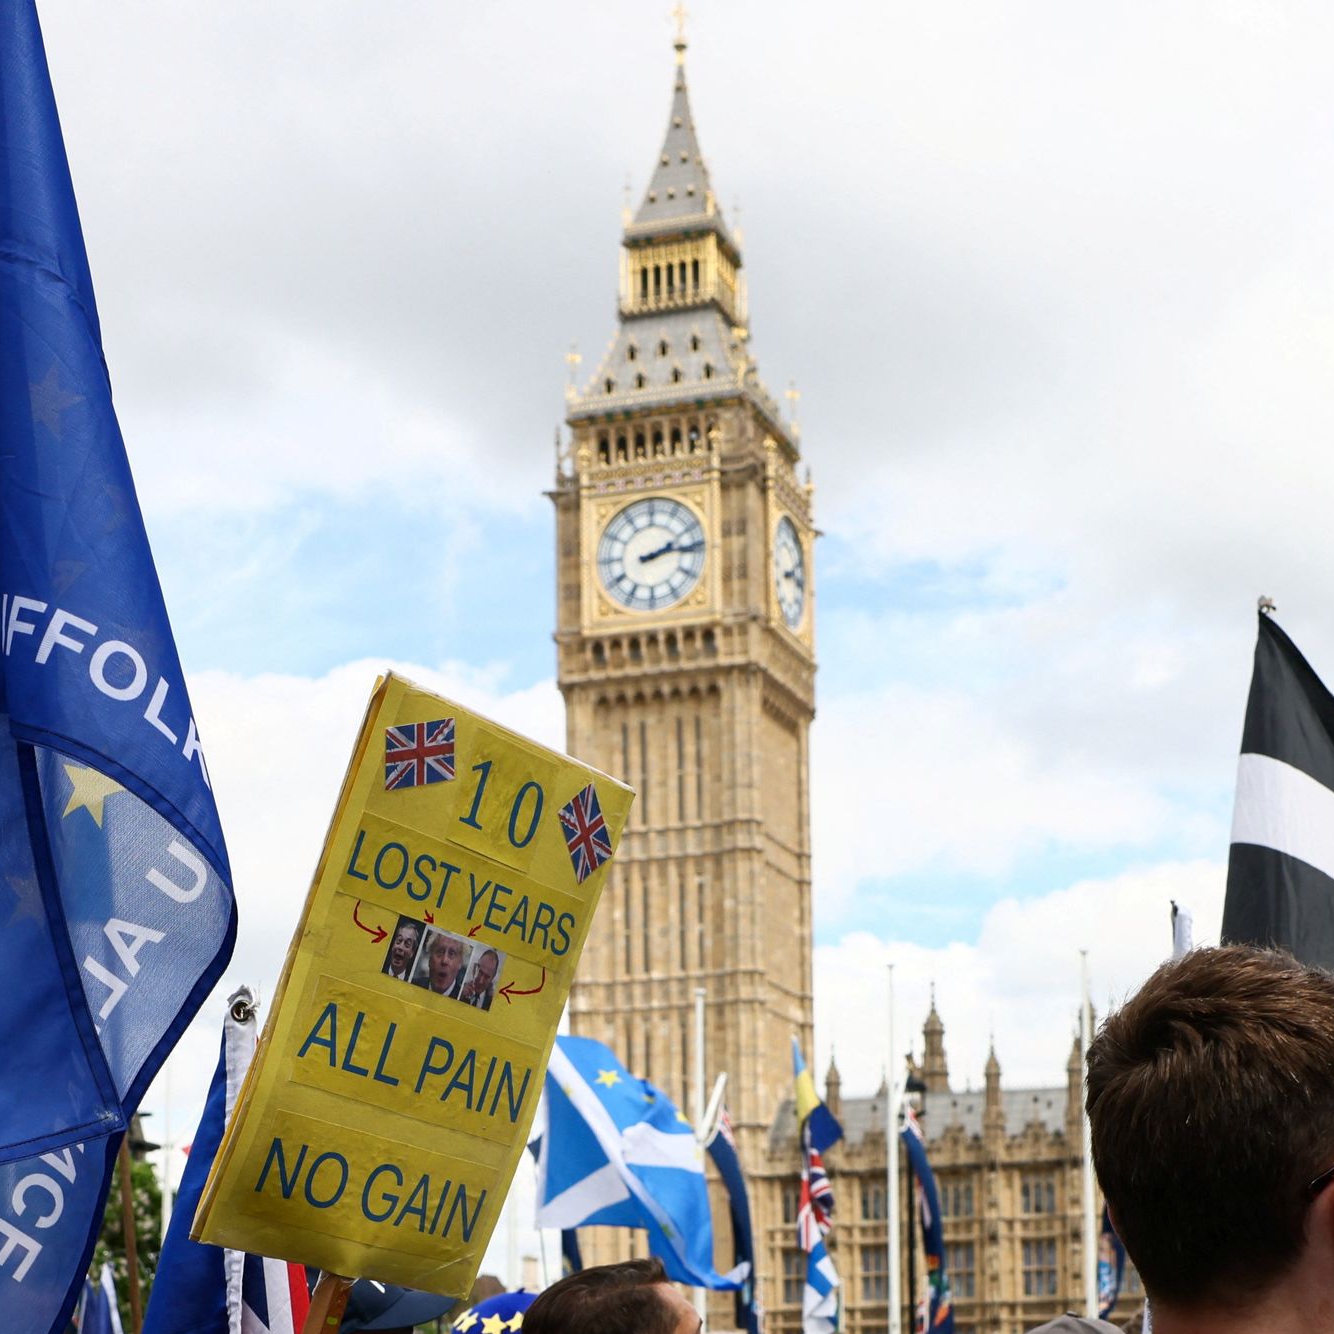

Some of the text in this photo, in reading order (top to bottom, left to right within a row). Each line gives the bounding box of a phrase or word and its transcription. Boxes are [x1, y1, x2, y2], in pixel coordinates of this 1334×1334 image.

[2, 593, 213, 791] FFOLK
[458, 760, 545, 849] 10
[347, 829, 576, 958] LOST YEARS
[297, 1002, 533, 1124] ALL PAIN
[255, 1138, 488, 1243] NO GAIN
